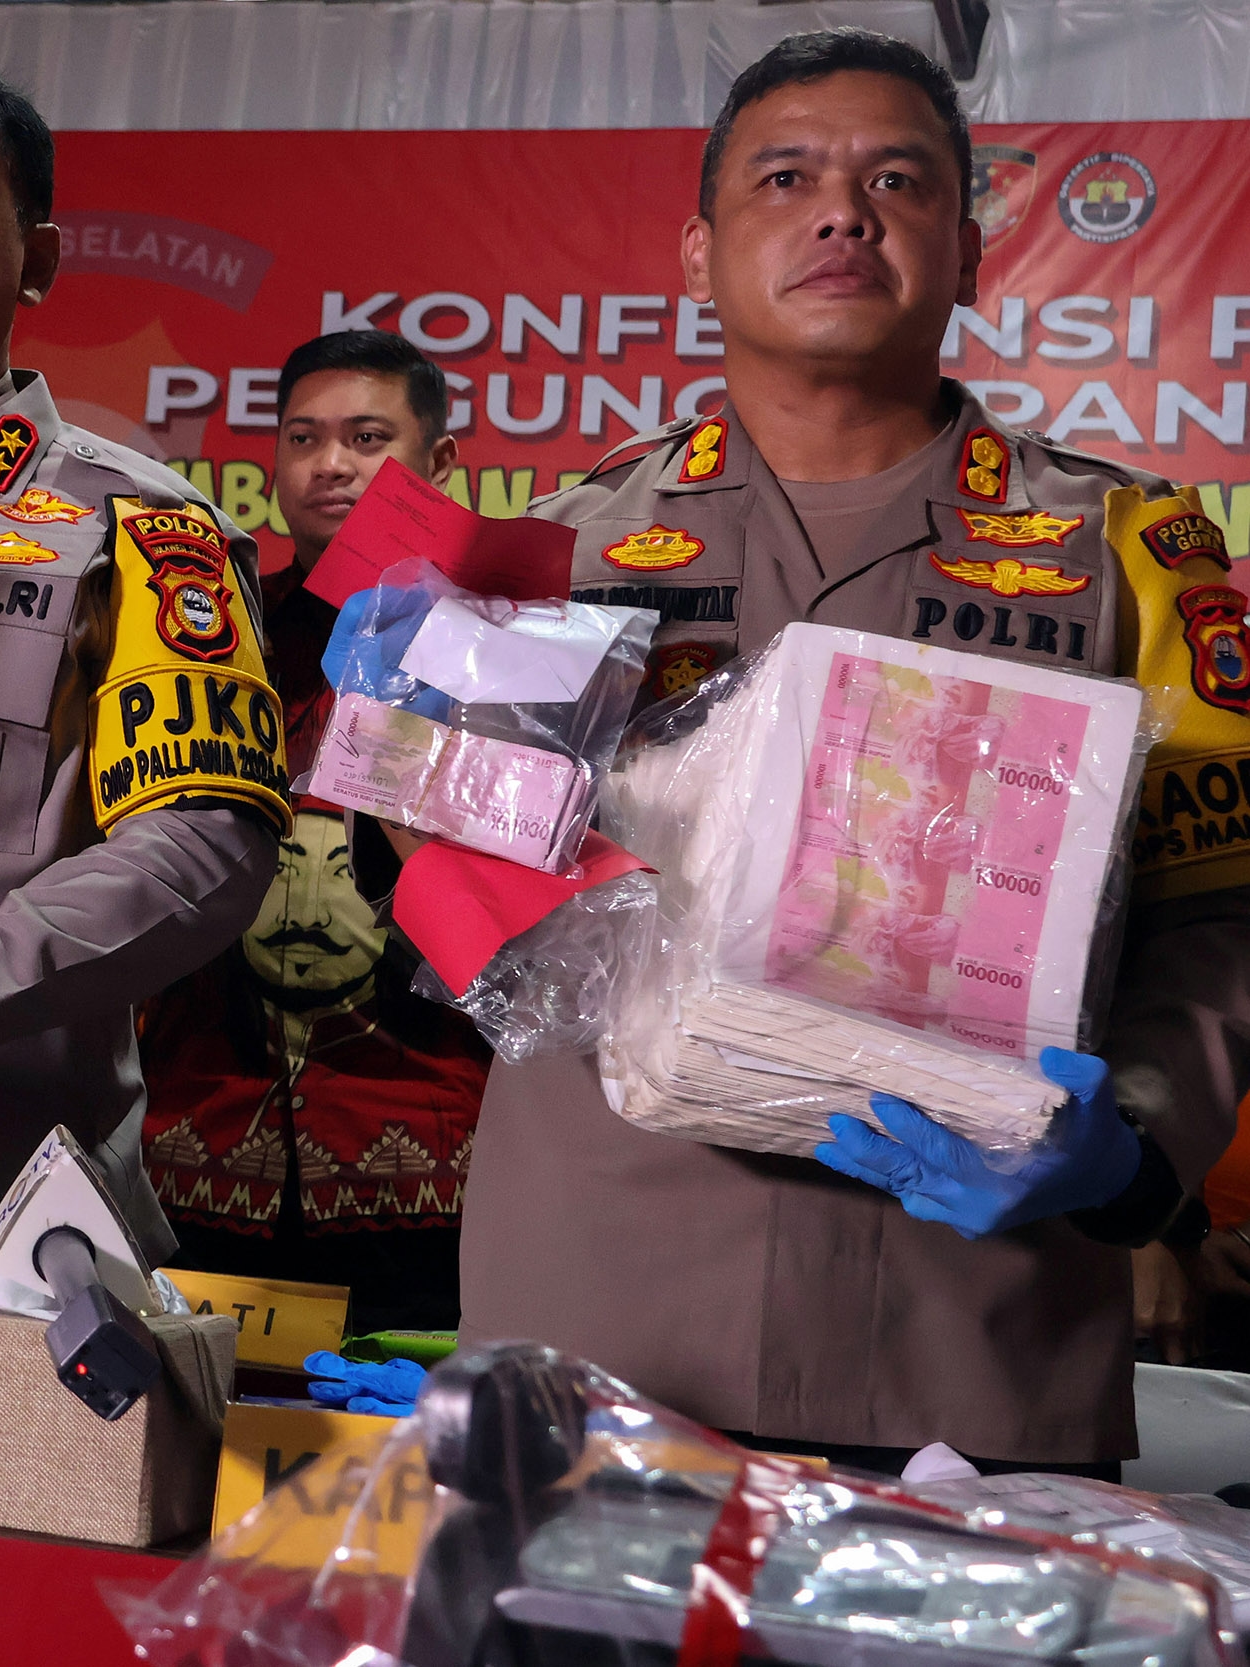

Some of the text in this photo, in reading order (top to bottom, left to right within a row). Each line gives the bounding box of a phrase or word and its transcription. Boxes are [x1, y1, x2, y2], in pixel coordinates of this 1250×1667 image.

[135, 516, 220, 549] POLDA
[912, 597, 1086, 661] POLRI
[119, 673, 279, 754] PJKO
[997, 766, 1064, 796] 100000
[956, 962, 1022, 989] 100000
